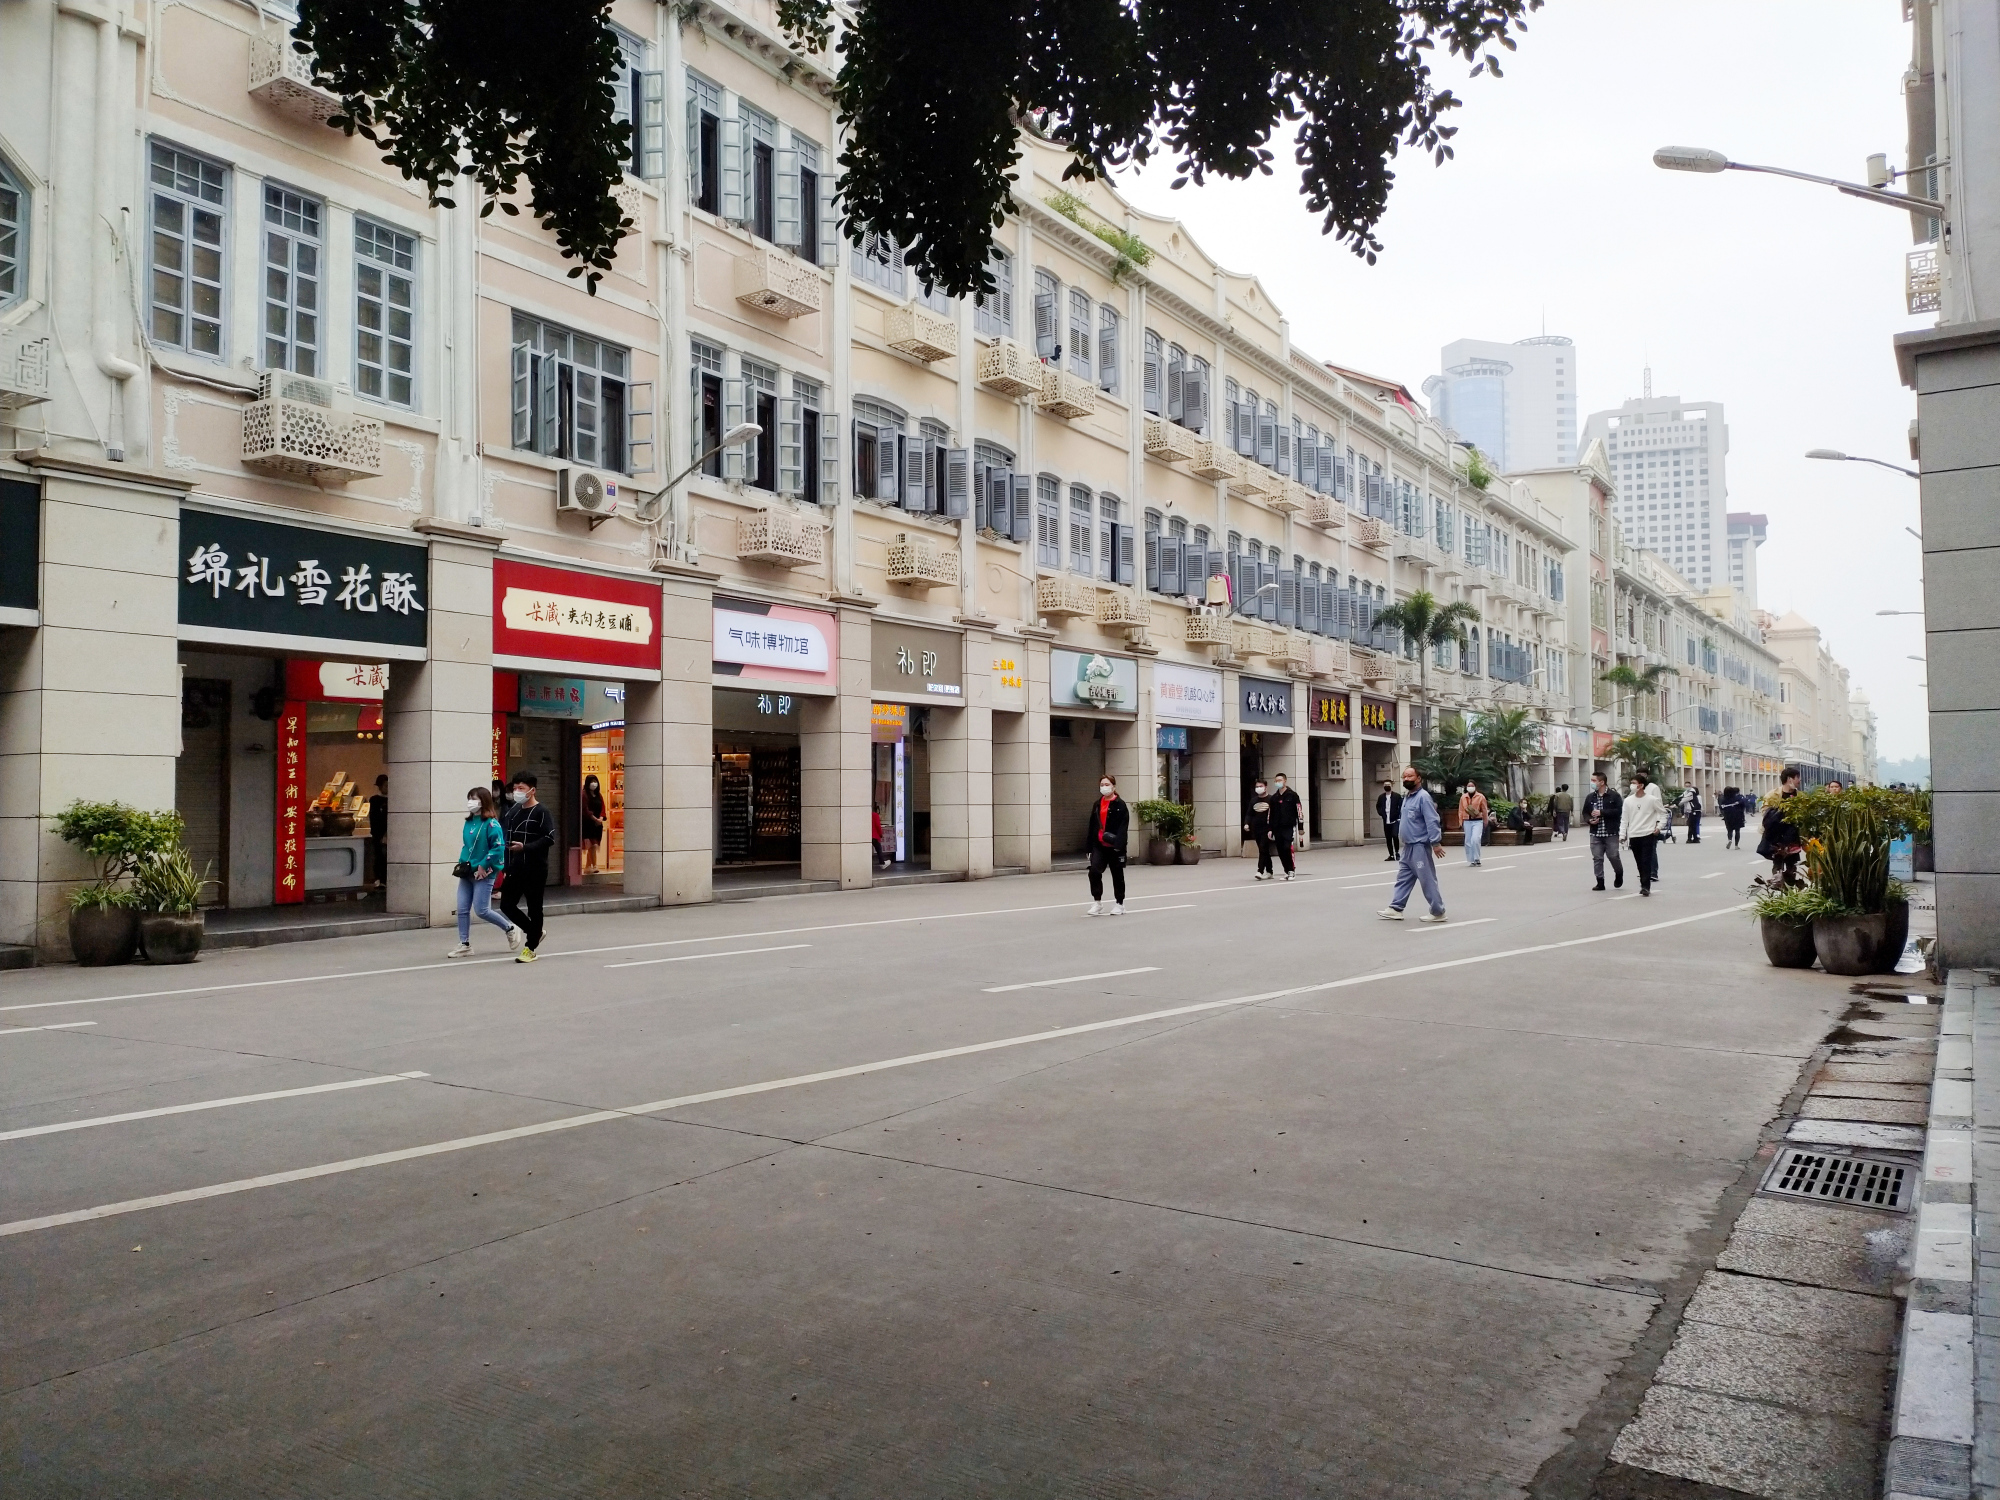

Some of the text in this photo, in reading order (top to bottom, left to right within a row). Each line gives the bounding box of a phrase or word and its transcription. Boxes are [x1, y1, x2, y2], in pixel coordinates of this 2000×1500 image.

[186, 543, 425, 616] 绵礼雪花酥
[728, 627, 809, 655] 气味博物馆
[1248, 691, 1287, 714] 恒久珍珠
